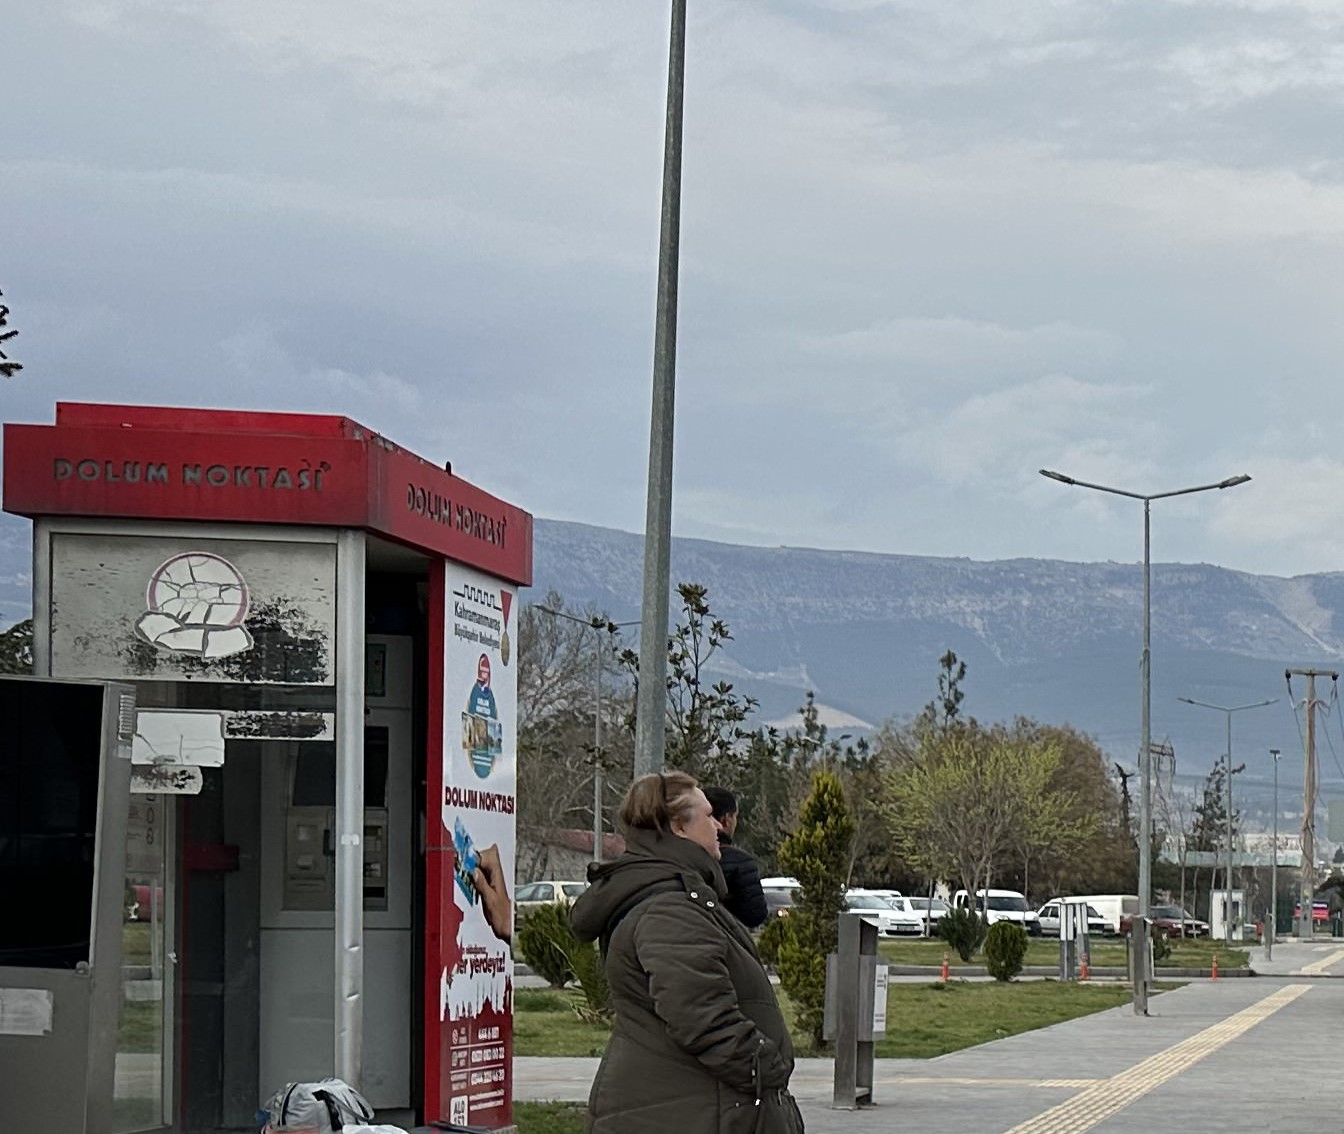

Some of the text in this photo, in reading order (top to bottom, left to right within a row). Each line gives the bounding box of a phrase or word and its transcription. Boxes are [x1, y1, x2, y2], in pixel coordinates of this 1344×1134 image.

[54, 458, 169, 484] DOLUM
[406, 483, 452, 528] DOLUM
[445, 786, 515, 815] DOLUM NOKTASI
